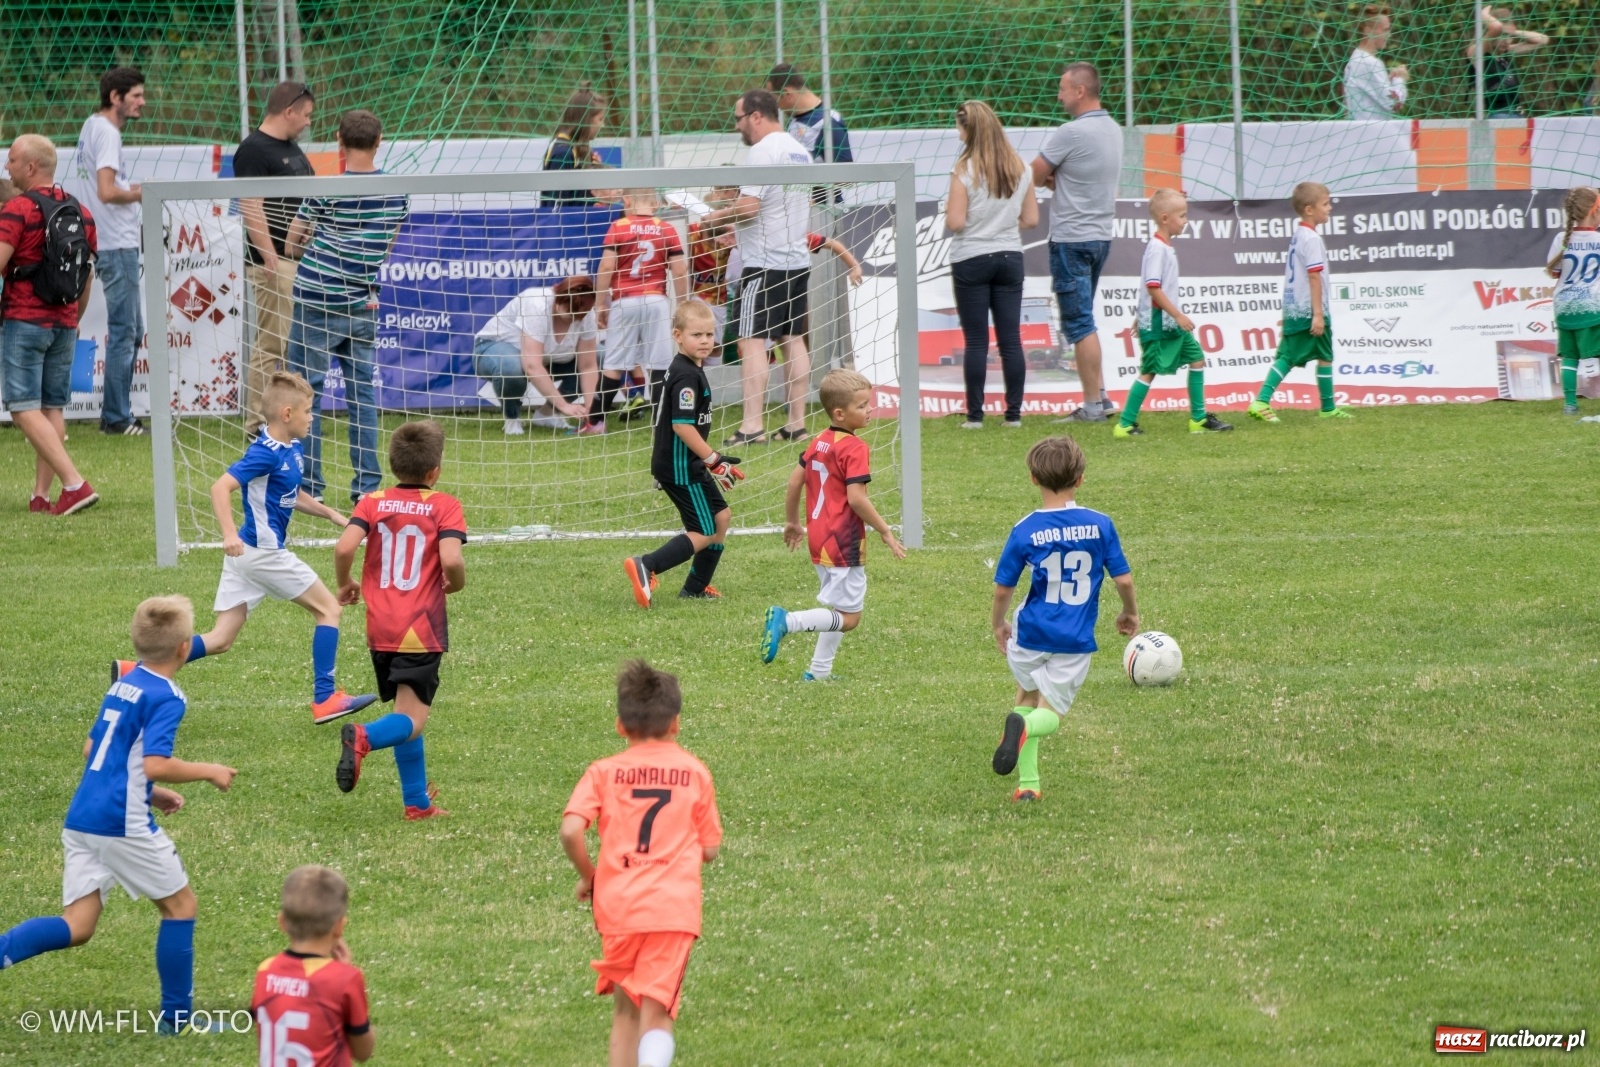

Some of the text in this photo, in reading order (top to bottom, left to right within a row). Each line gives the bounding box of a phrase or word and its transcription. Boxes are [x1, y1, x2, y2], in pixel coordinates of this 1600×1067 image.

[1209, 219, 1234, 239] W
[1353, 208, 1426, 235] SALON
[1433, 204, 1525, 231] PODŁÓG
[1531, 208, 1539, 229] I
[1567, 242, 1600, 251] AULINA
[378, 257, 589, 283] TOWO-BUDOWLANE
[1562, 252, 1600, 285] 20
[1201, 282, 1278, 297] POTRZEBNE
[1104, 305, 1124, 317] DO
[1239, 299, 1282, 312] DOMU
[1349, 303, 1377, 311] DRZWI
[1383, 301, 1408, 310] OKNA
[385, 312, 451, 332] Pielczyk
[1337, 336, 1432, 348] WIŚNIOWSKI
[1338, 360, 1434, 379] CLASSEN
[877, 391, 963, 413] RYNIK
[1150, 396, 1189, 410] (obo
[1271, 389, 1311, 404] el.:
[812, 459, 830, 520] 7
[377, 500, 433, 516] KSAWERY
[1030, 524, 1101, 547] 1908 NĘDZA
[378, 521, 427, 591] 10
[1040, 550, 1093, 606] 13
[89, 707, 122, 772] 7
[614, 767, 691, 788] RONALDO
[631, 788, 672, 854] 7
[257, 1004, 316, 1067] 16
